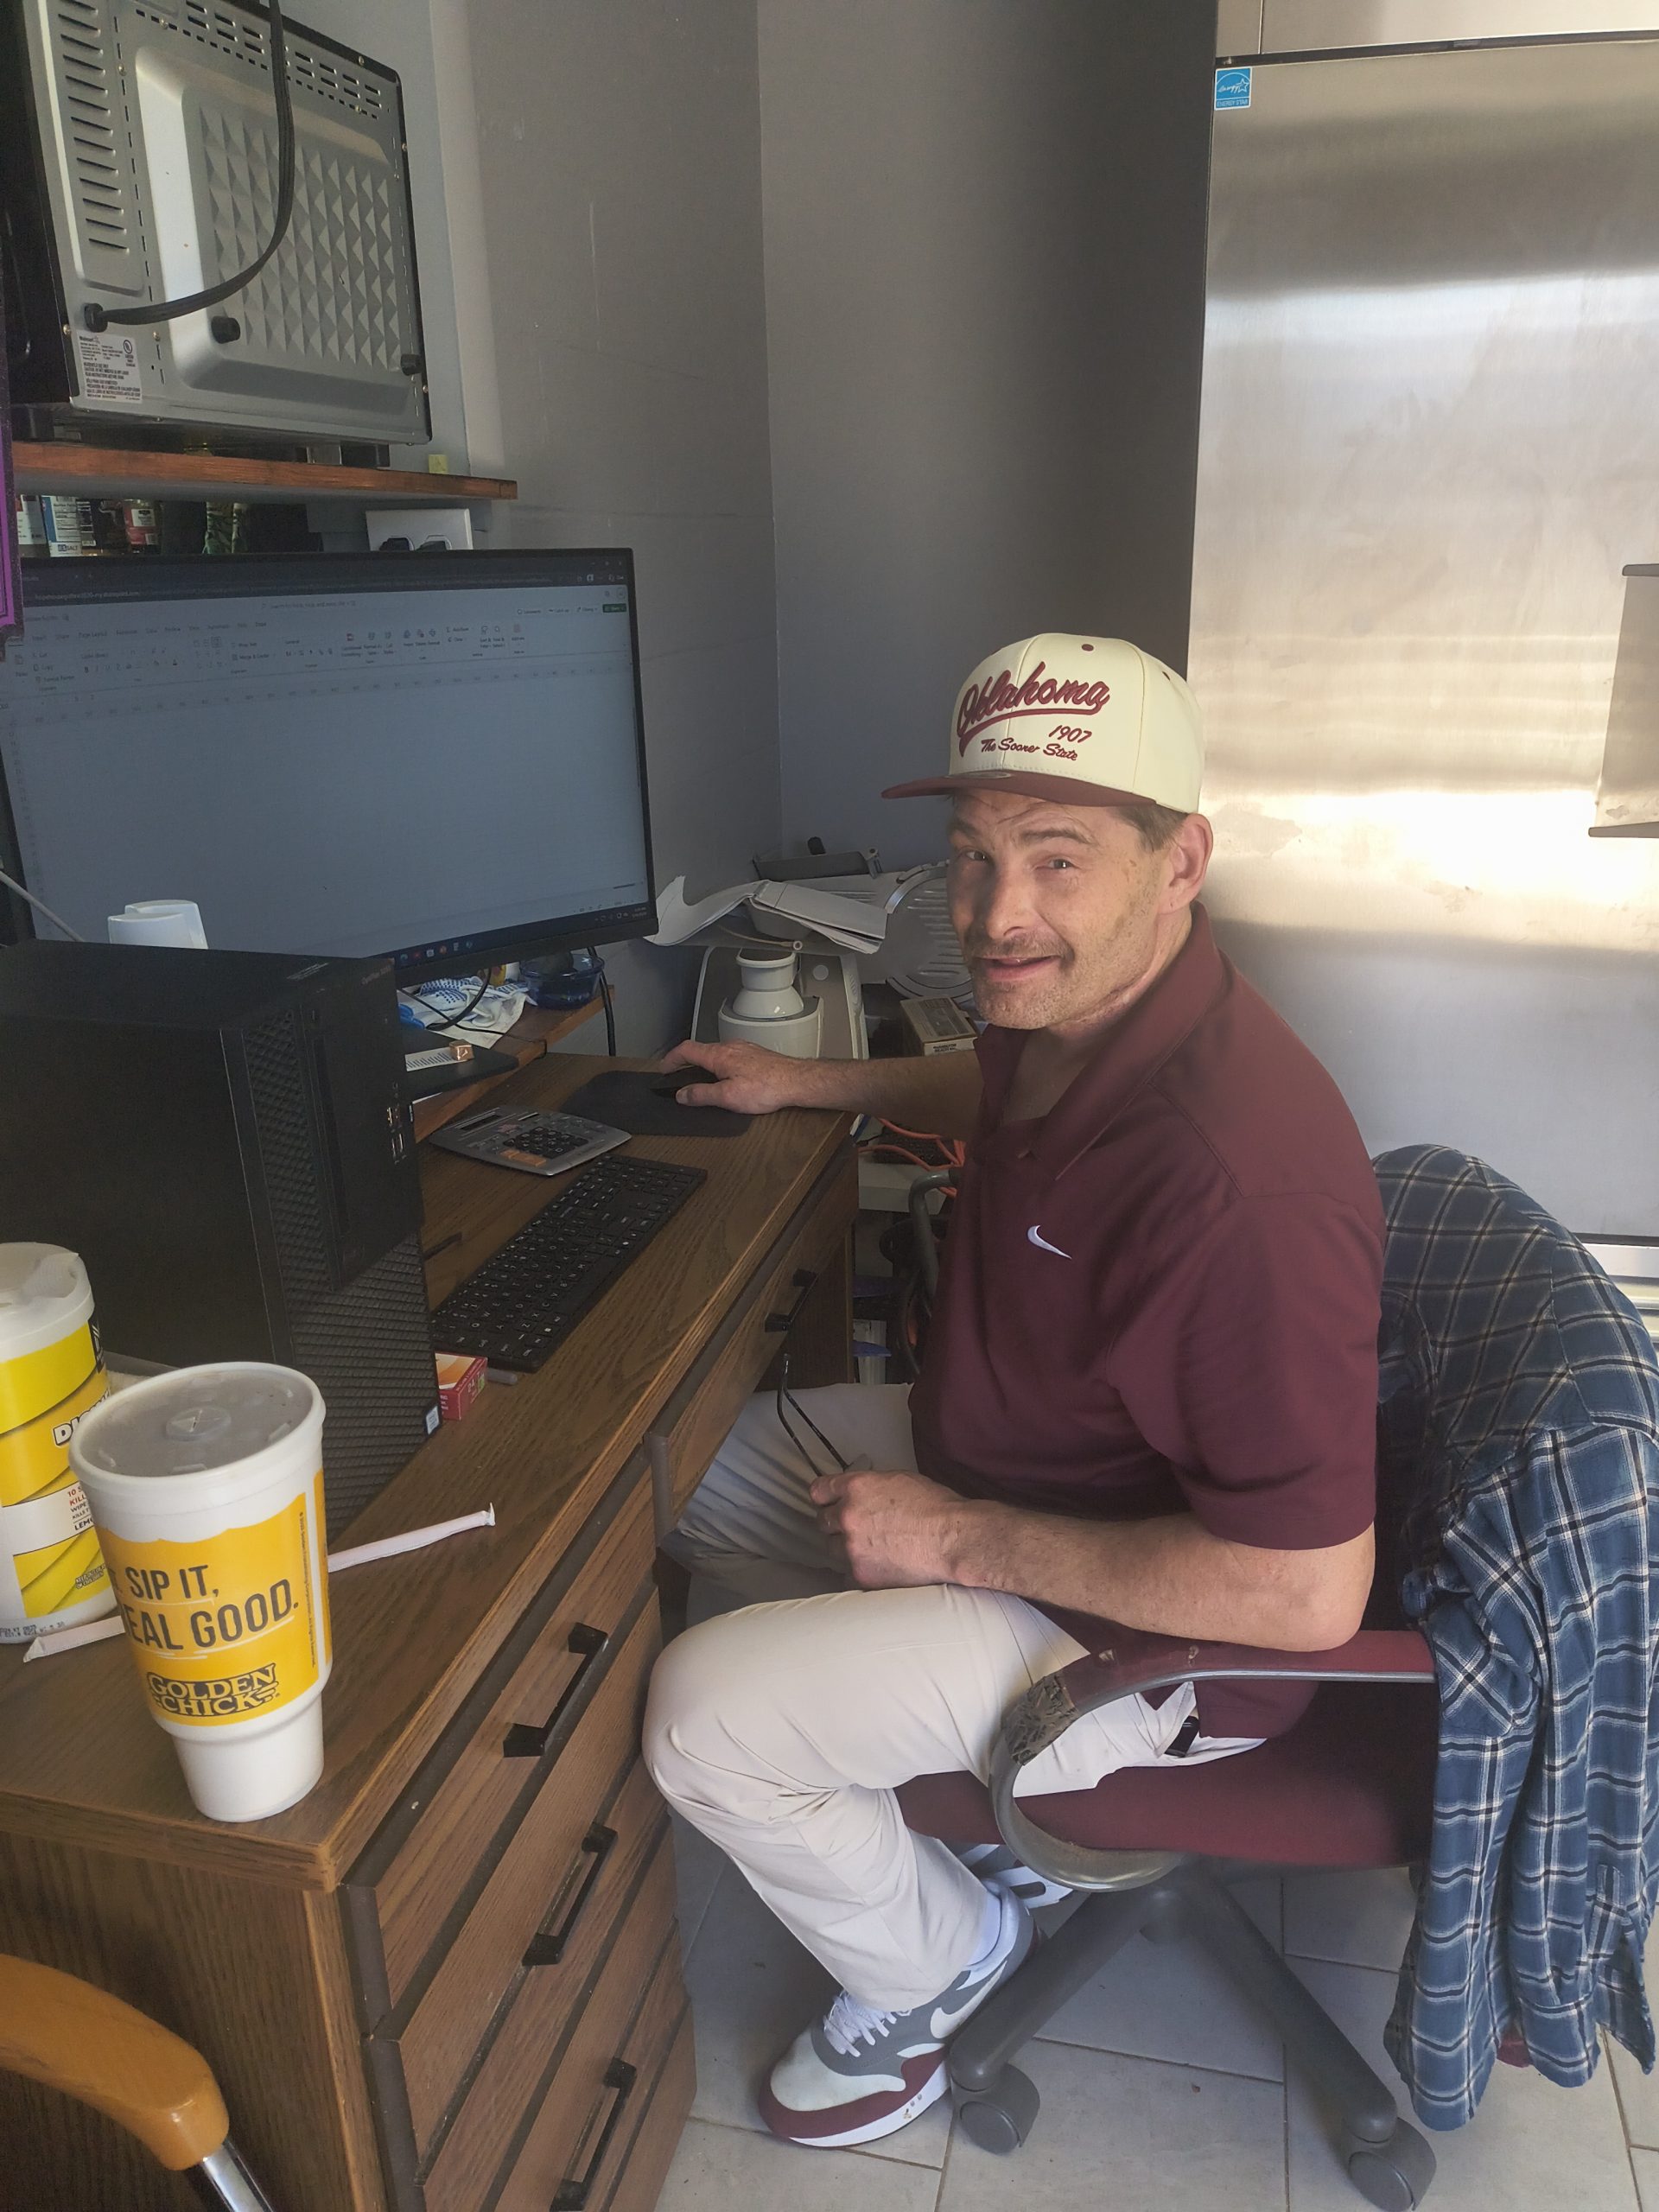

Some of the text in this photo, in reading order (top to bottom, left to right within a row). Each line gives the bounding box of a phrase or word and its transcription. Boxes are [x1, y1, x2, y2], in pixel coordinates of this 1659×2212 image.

[957, 661, 1110, 739] Oklahoma
[981, 737, 1078, 761] The Sooner State
[1048, 725, 1093, 744] 1907
[67, 1489, 77, 1497] 10
[125, 1567, 170, 1600] SIP
[179, 1565, 219, 1598] IT,
[121, 1579, 299, 1650] EAL GOOD.
[148, 1662, 276, 1700] GOLDEN
[160, 1690, 263, 1716] CHICK
